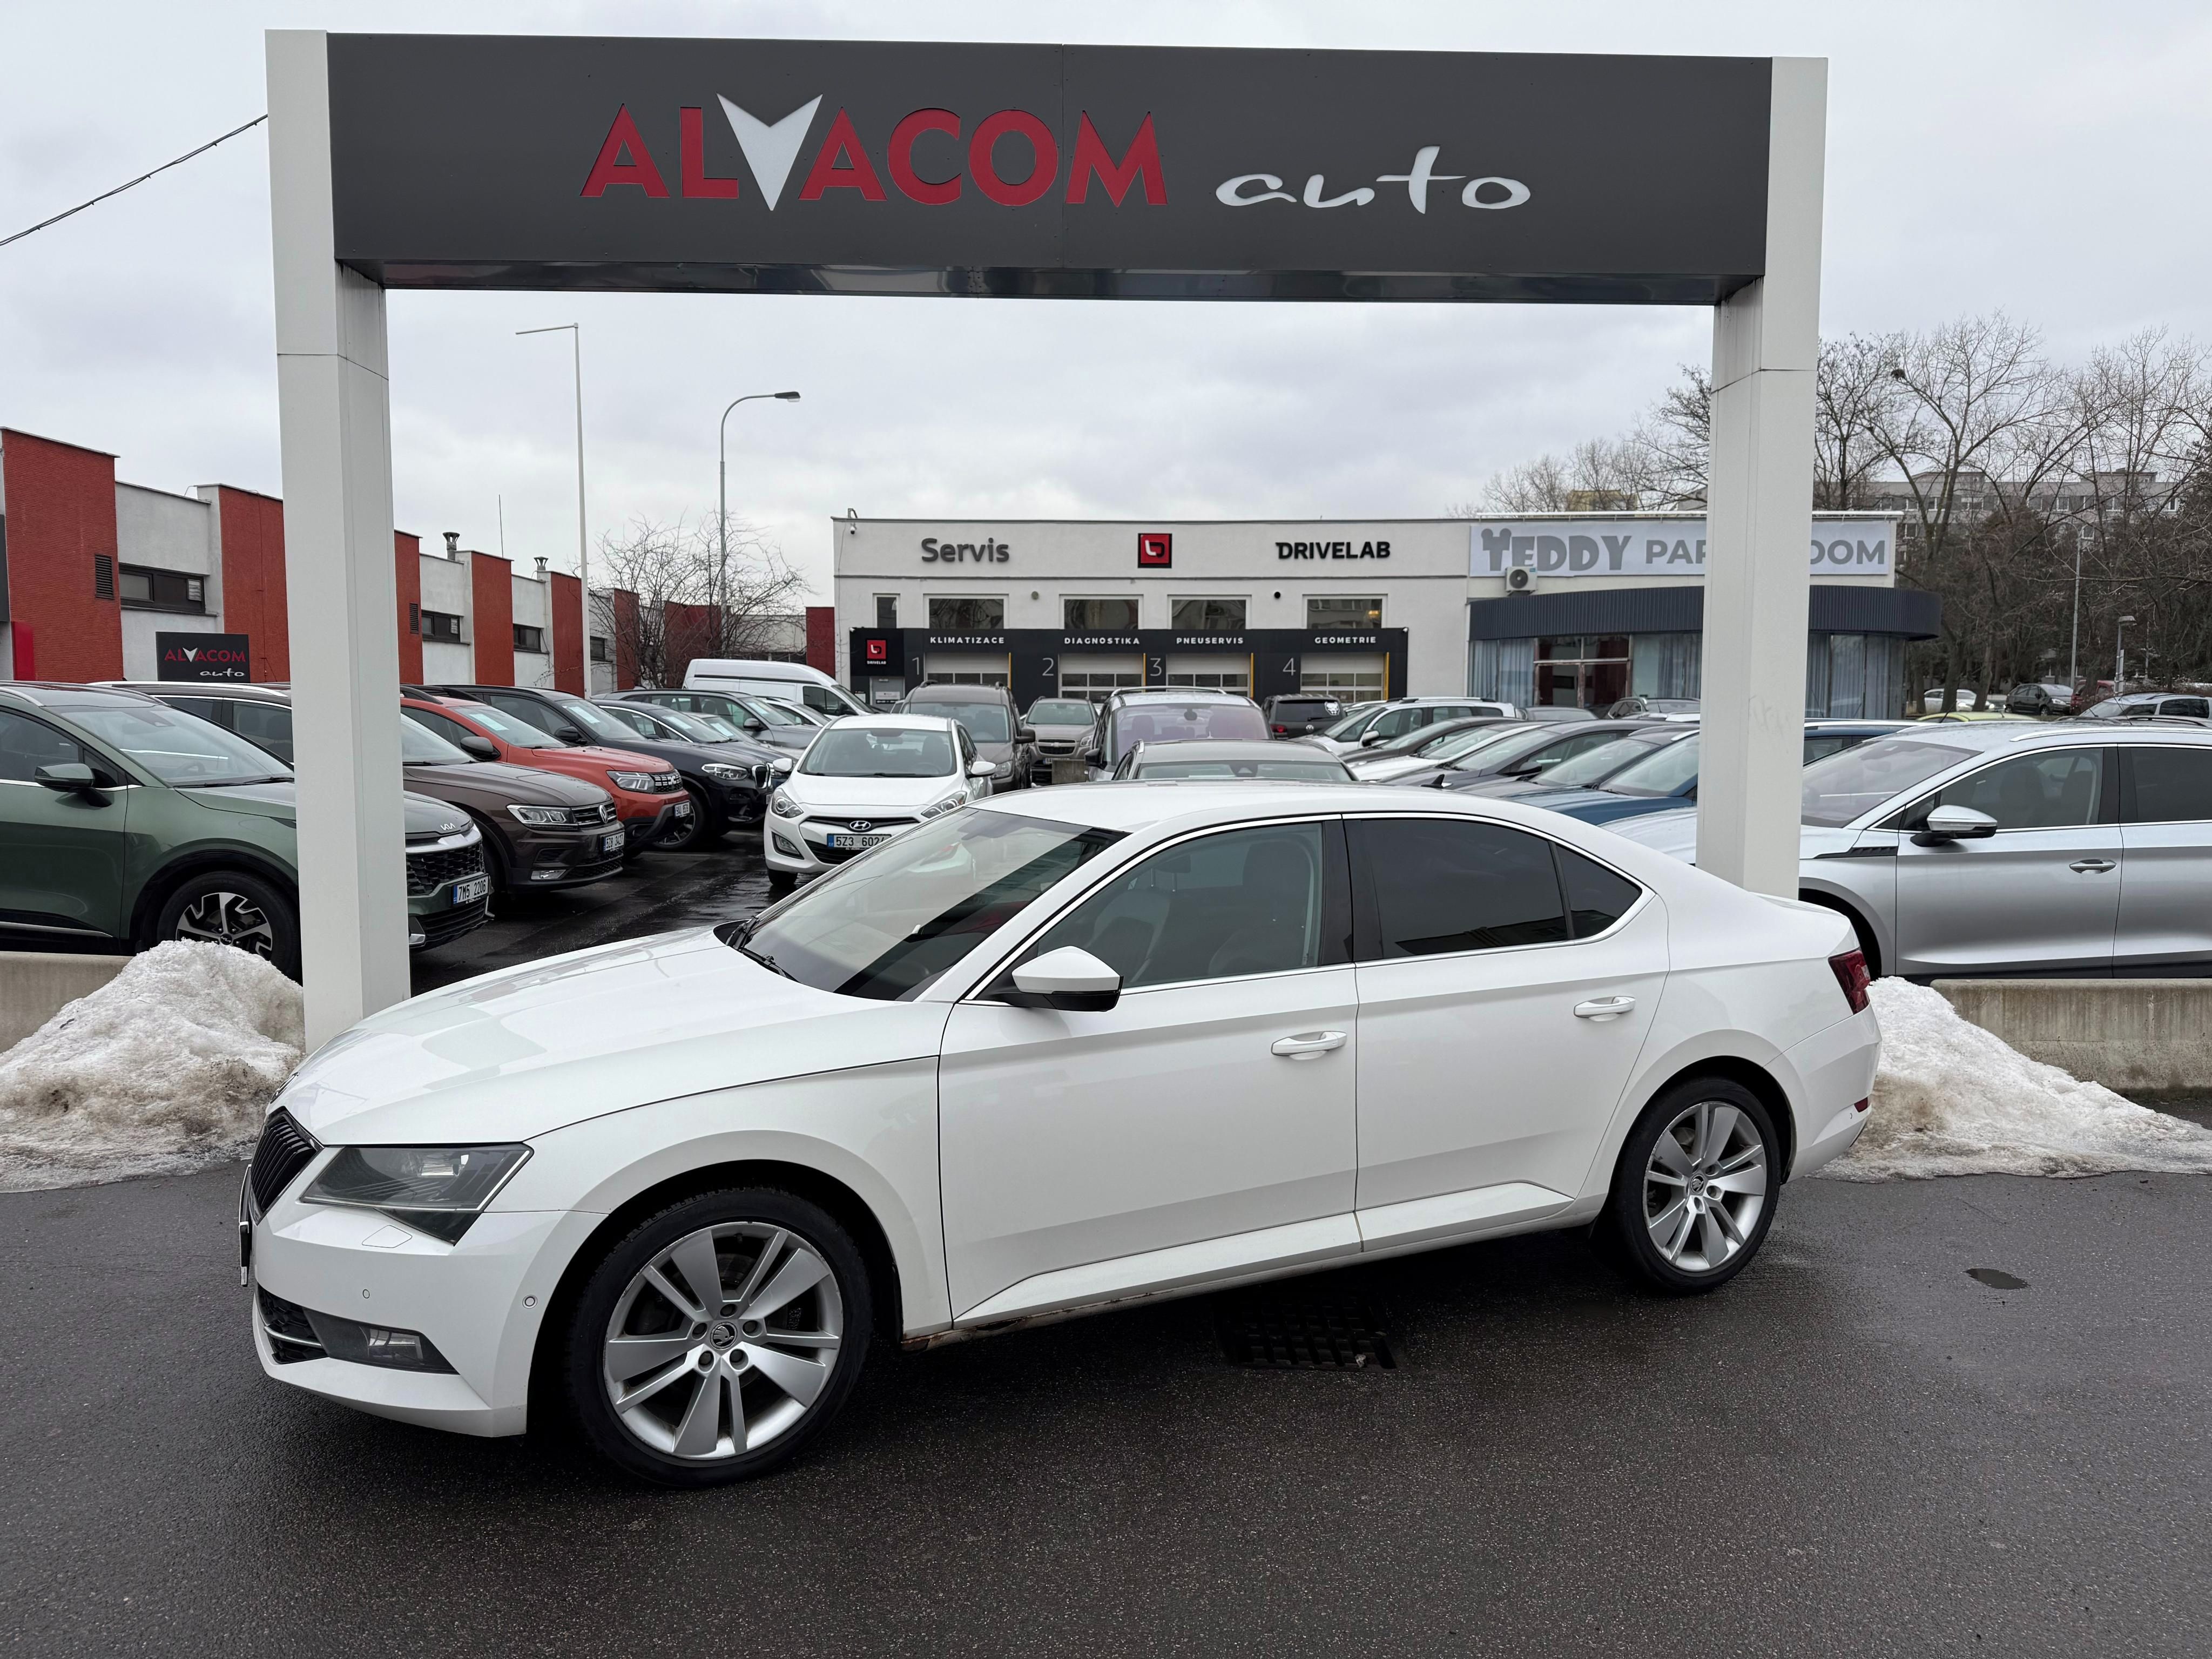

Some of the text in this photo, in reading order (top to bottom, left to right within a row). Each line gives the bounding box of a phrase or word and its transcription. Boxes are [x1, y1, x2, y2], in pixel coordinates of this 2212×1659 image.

[580, 93, 1531, 214] ALVACOM auto
[921, 537, 1009, 562] Servis
[1275, 542, 1391, 559] DRIVELAB
[1481, 528, 1631, 571] TEDDY
[164, 648, 246, 662] ALVACOM
[199, 667, 245, 677] auto
[912, 657, 920, 675] 1
[1042, 658, 1054, 676] 2
[1150, 658, 1162, 676] 3
[1283, 657, 1296, 676] 4
[836, 837, 854, 846] 5Z3
[458, 884, 470, 901] 7M5
[474, 880, 486, 895] 2206
